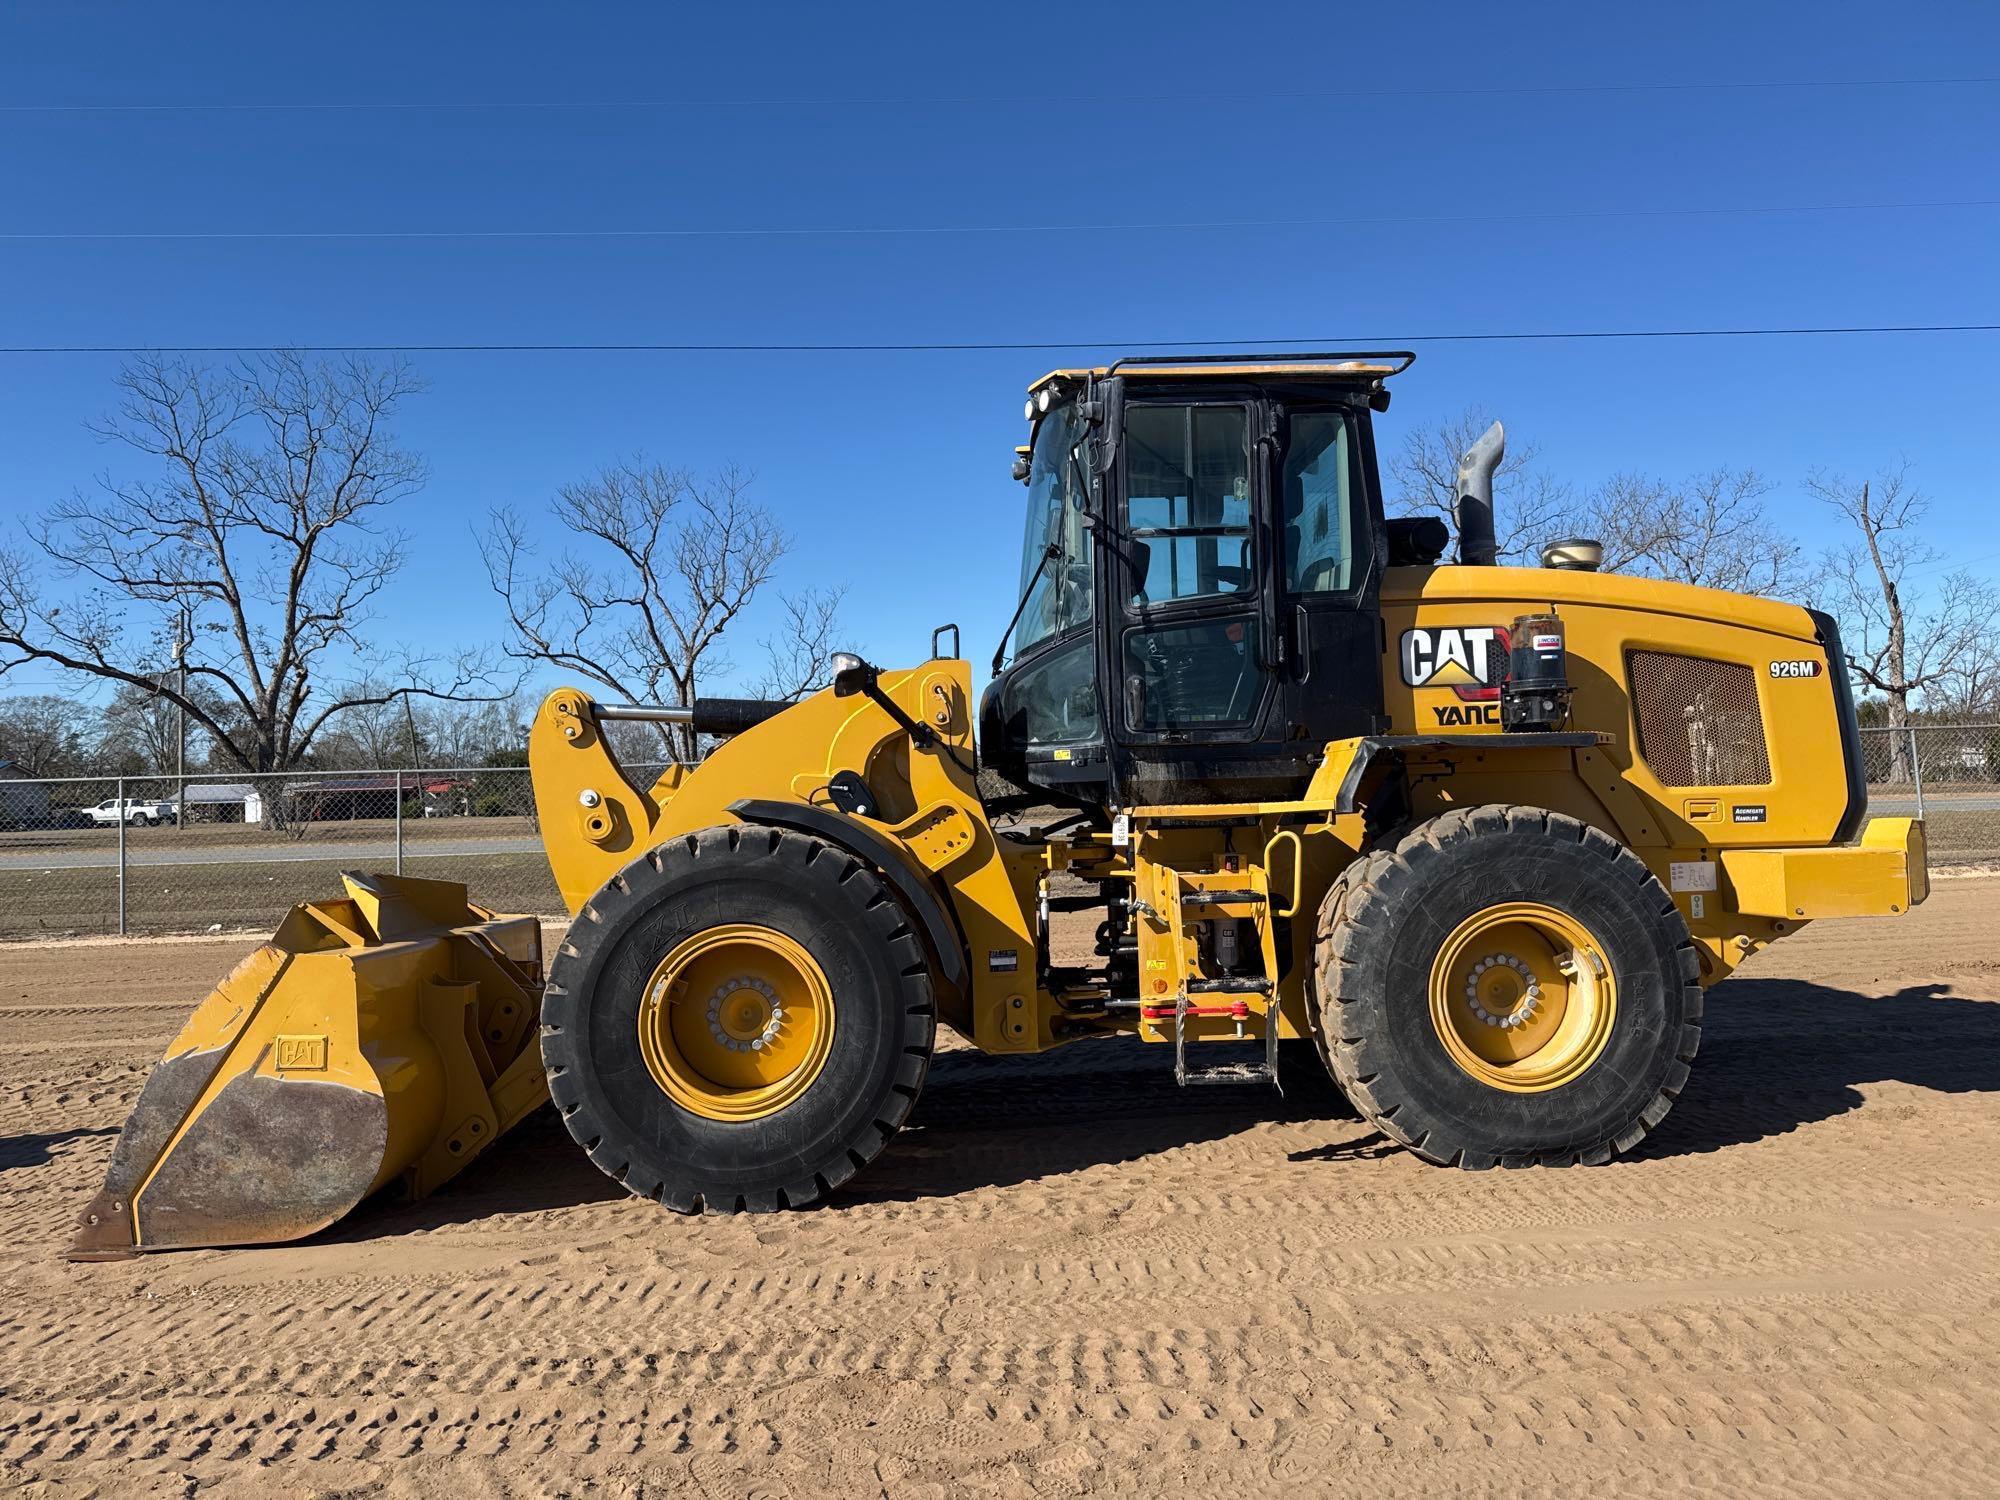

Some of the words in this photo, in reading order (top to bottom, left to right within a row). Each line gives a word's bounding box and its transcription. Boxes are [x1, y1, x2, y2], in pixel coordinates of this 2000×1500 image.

[1410, 628, 1494, 685] CAT
[1770, 661, 1814, 677] 926M
[1432, 704, 1501, 726] YANC
[280, 1041, 322, 1066] CAT
